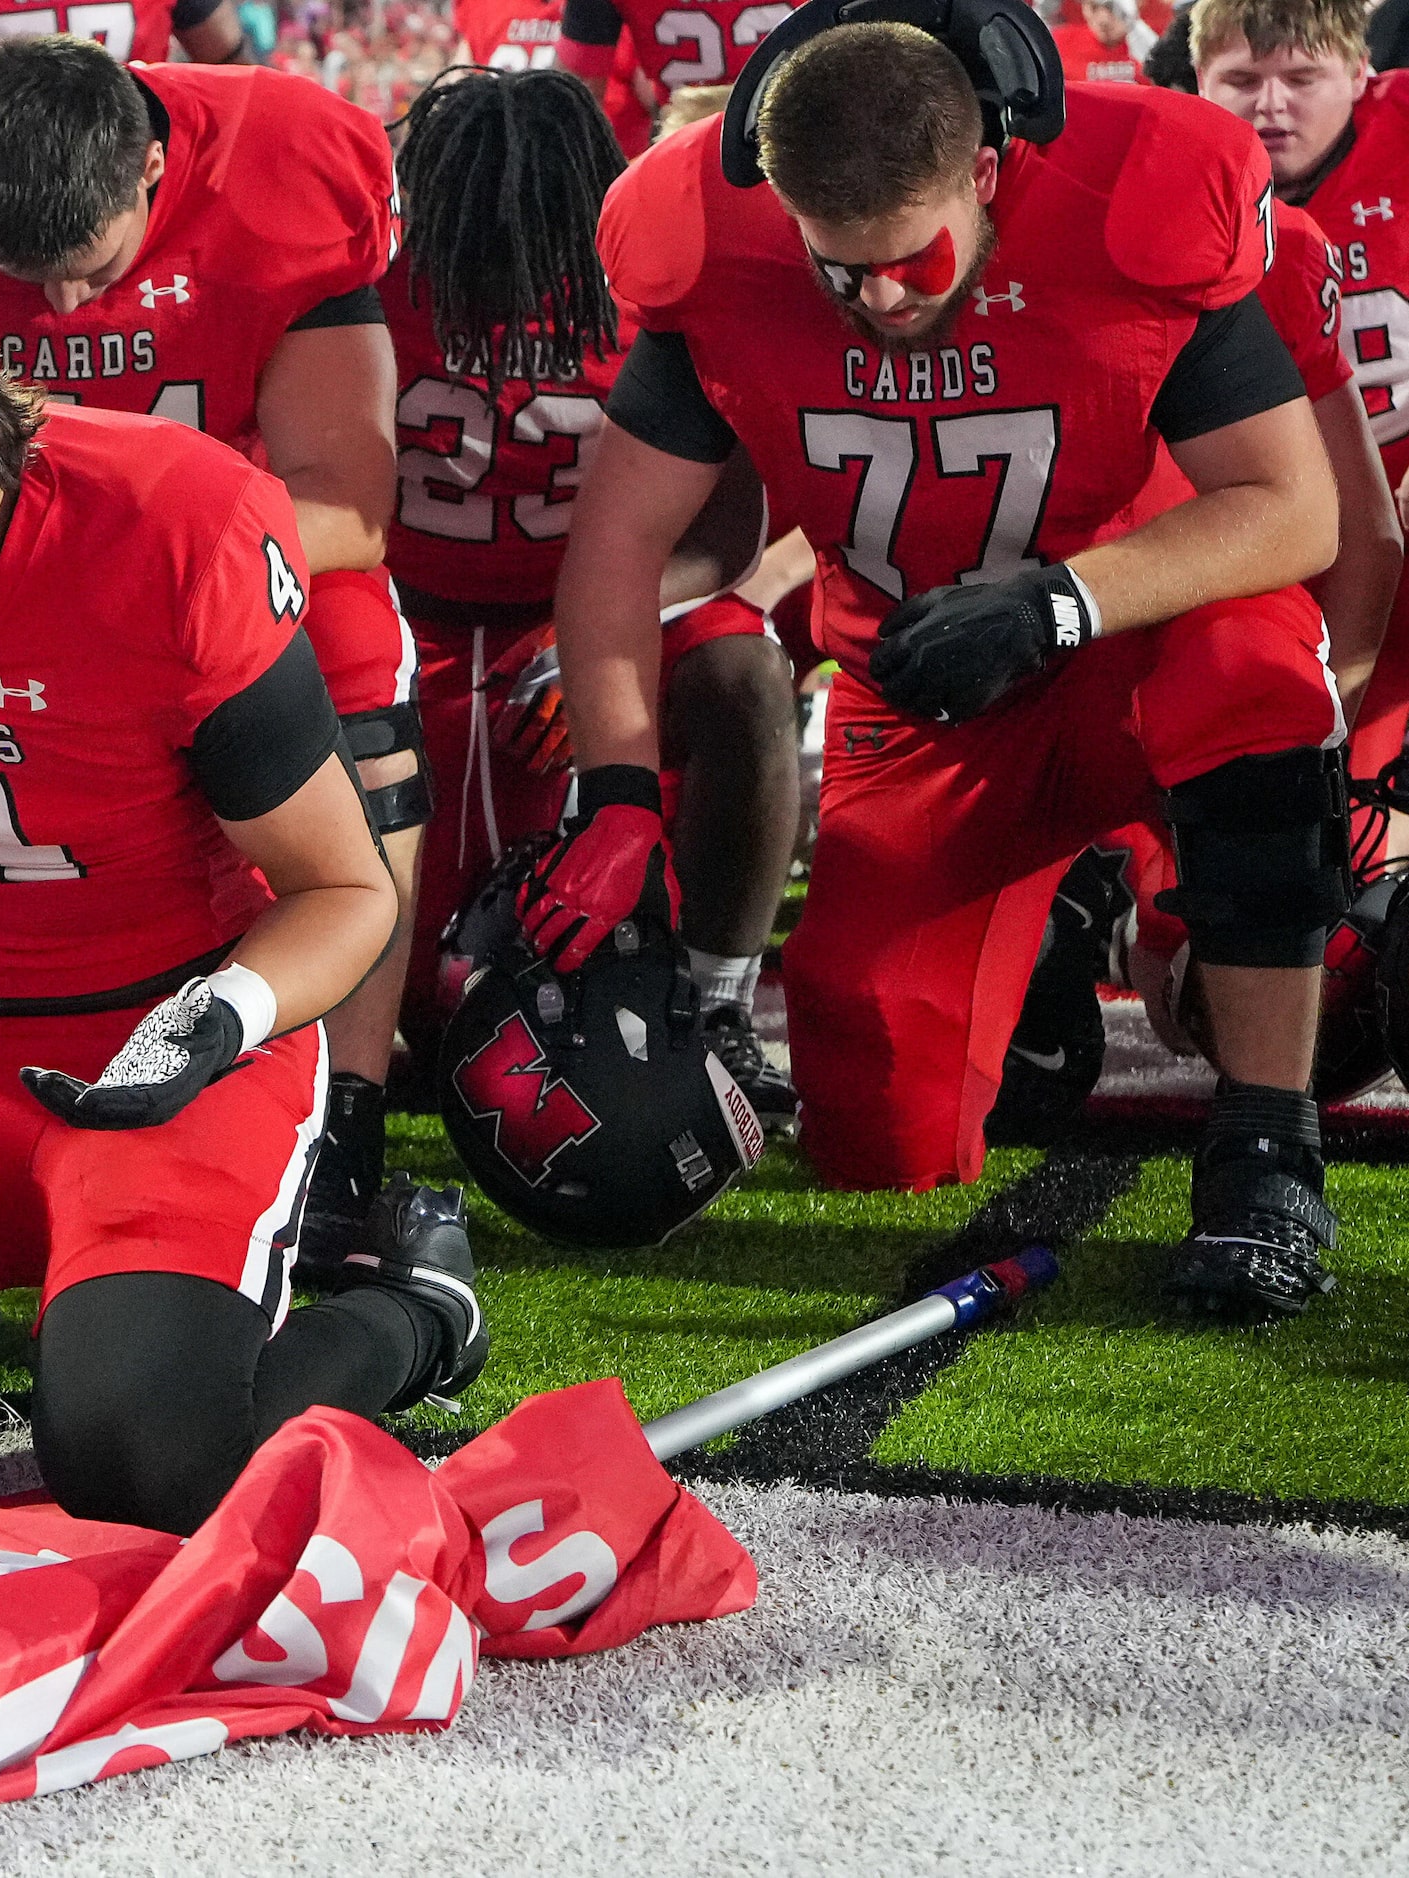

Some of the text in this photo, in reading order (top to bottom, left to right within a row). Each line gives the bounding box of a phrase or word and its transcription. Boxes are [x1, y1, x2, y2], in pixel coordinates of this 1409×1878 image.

[1, 329, 156, 381] CARDS
[843, 344, 998, 402] CARDS
[396, 375, 605, 543] 23
[798, 403, 1060, 603] 77
[260, 531, 306, 625] 4
[1049, 592, 1081, 647] NIKE
